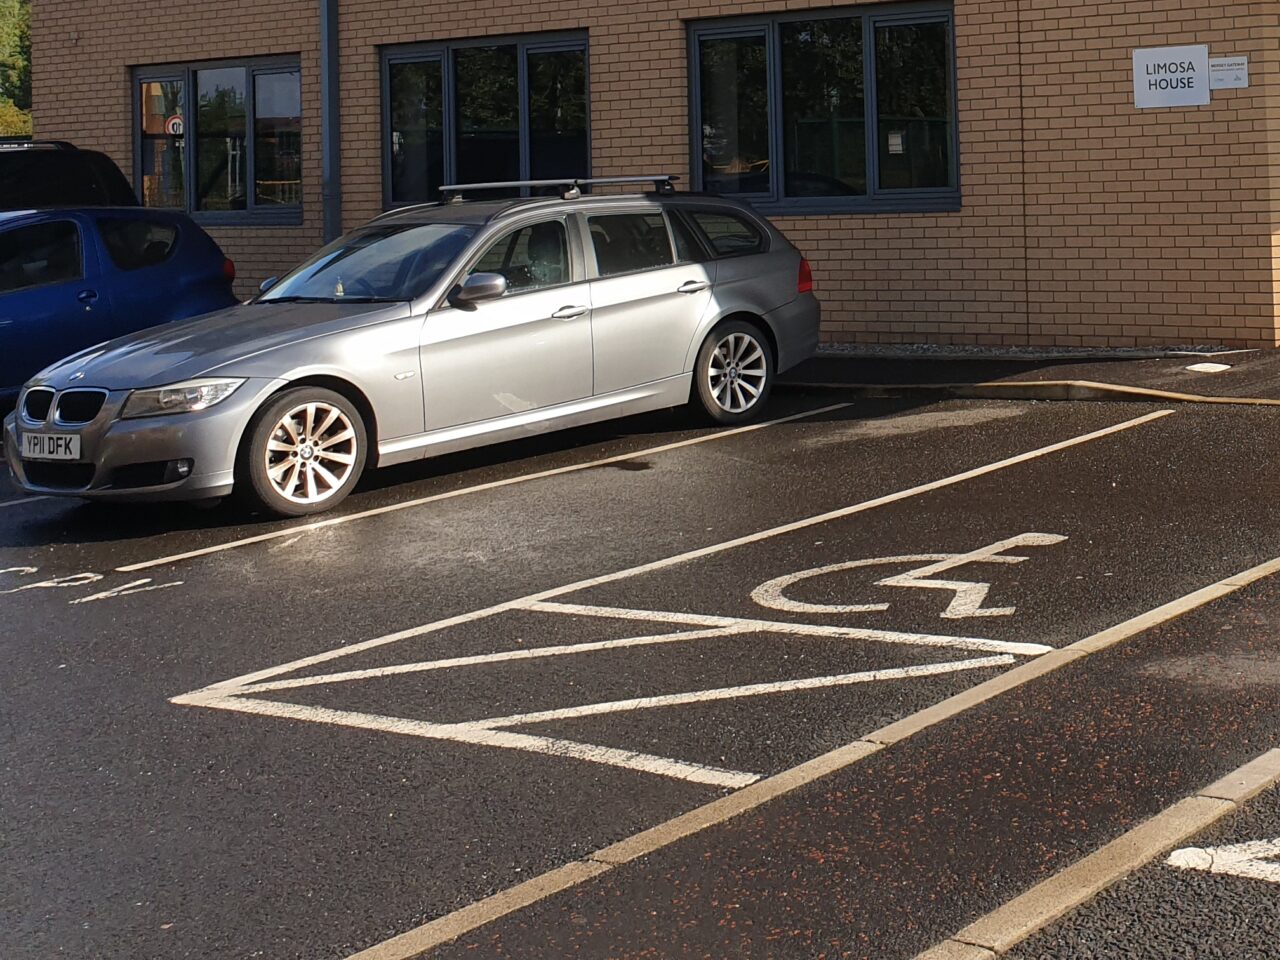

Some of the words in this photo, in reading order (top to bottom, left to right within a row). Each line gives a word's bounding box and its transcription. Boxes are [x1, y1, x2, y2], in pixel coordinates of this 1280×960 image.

[1146, 61, 1196, 75] LIMOSA
[1148, 77, 1194, 91] HOUSE
[26, 435, 45, 454] YP11
[48, 436, 73, 455] DFK
